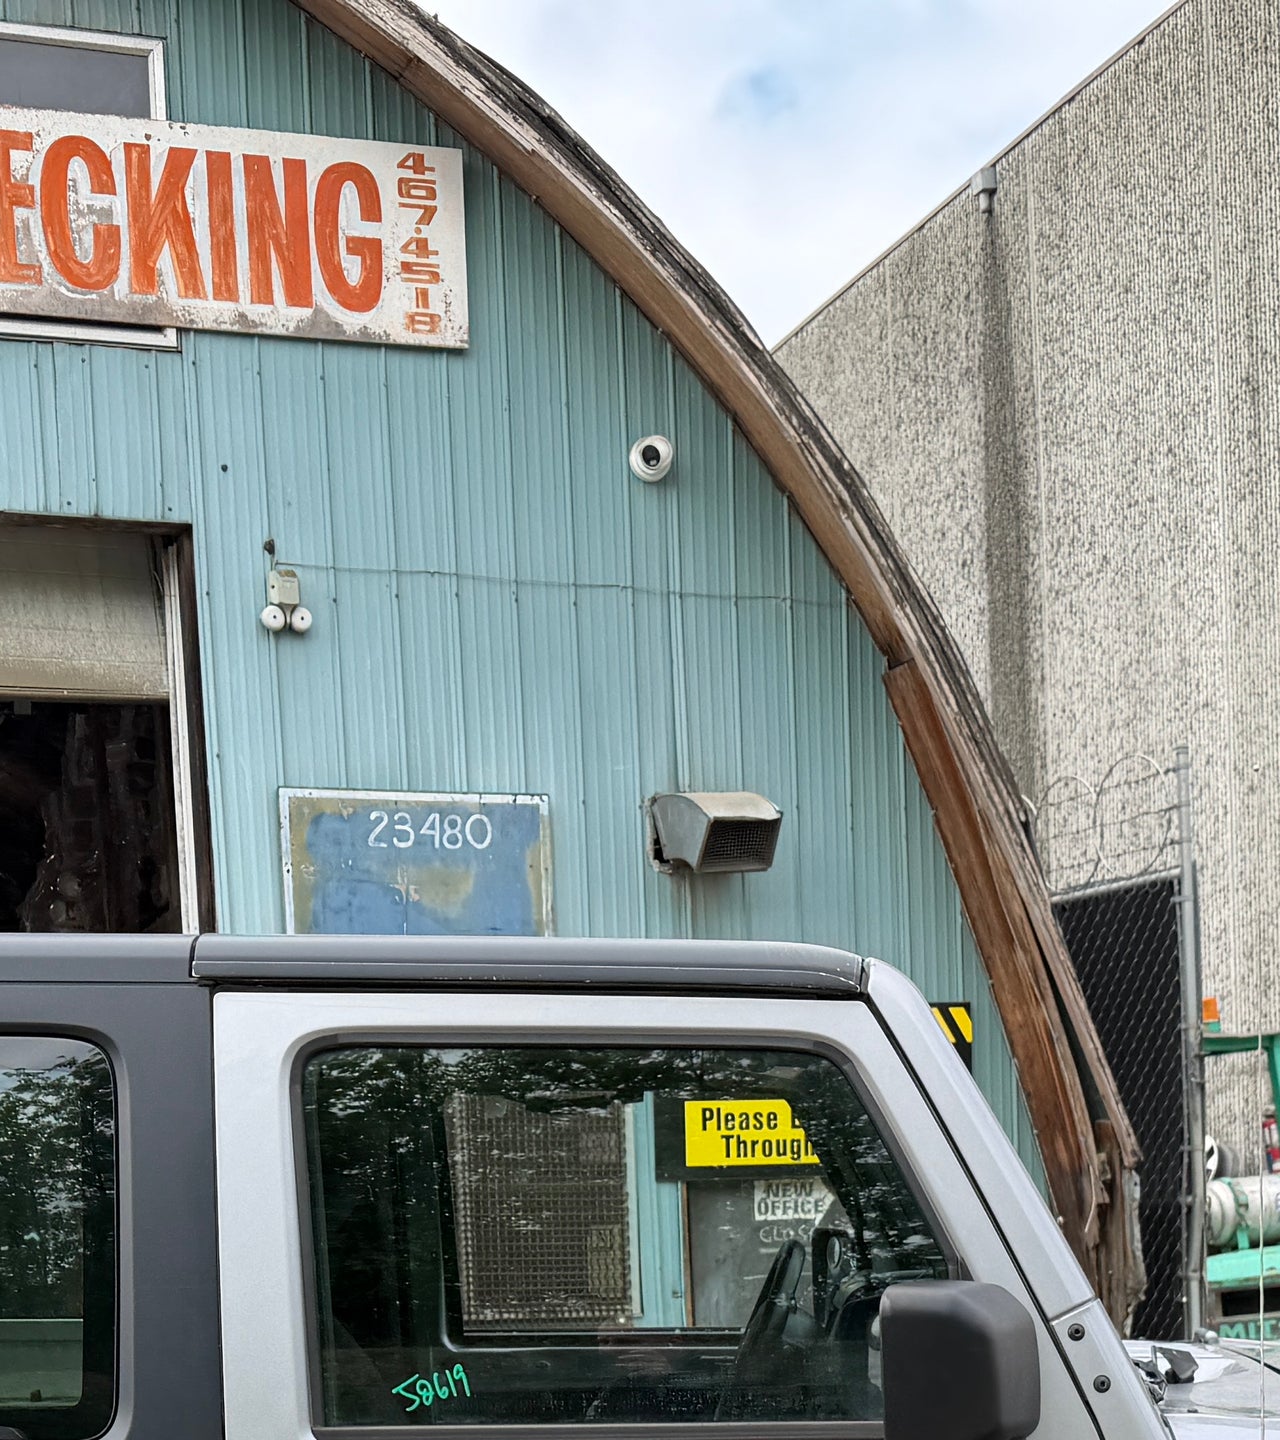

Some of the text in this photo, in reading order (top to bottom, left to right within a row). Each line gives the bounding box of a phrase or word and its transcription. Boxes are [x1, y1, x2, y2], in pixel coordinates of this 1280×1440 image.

[368, 811, 492, 850] 23480
[701, 1107, 778, 1131] Please
[764, 1181, 814, 1199] NEW
[757, 1198, 824, 1217] OFFICE
